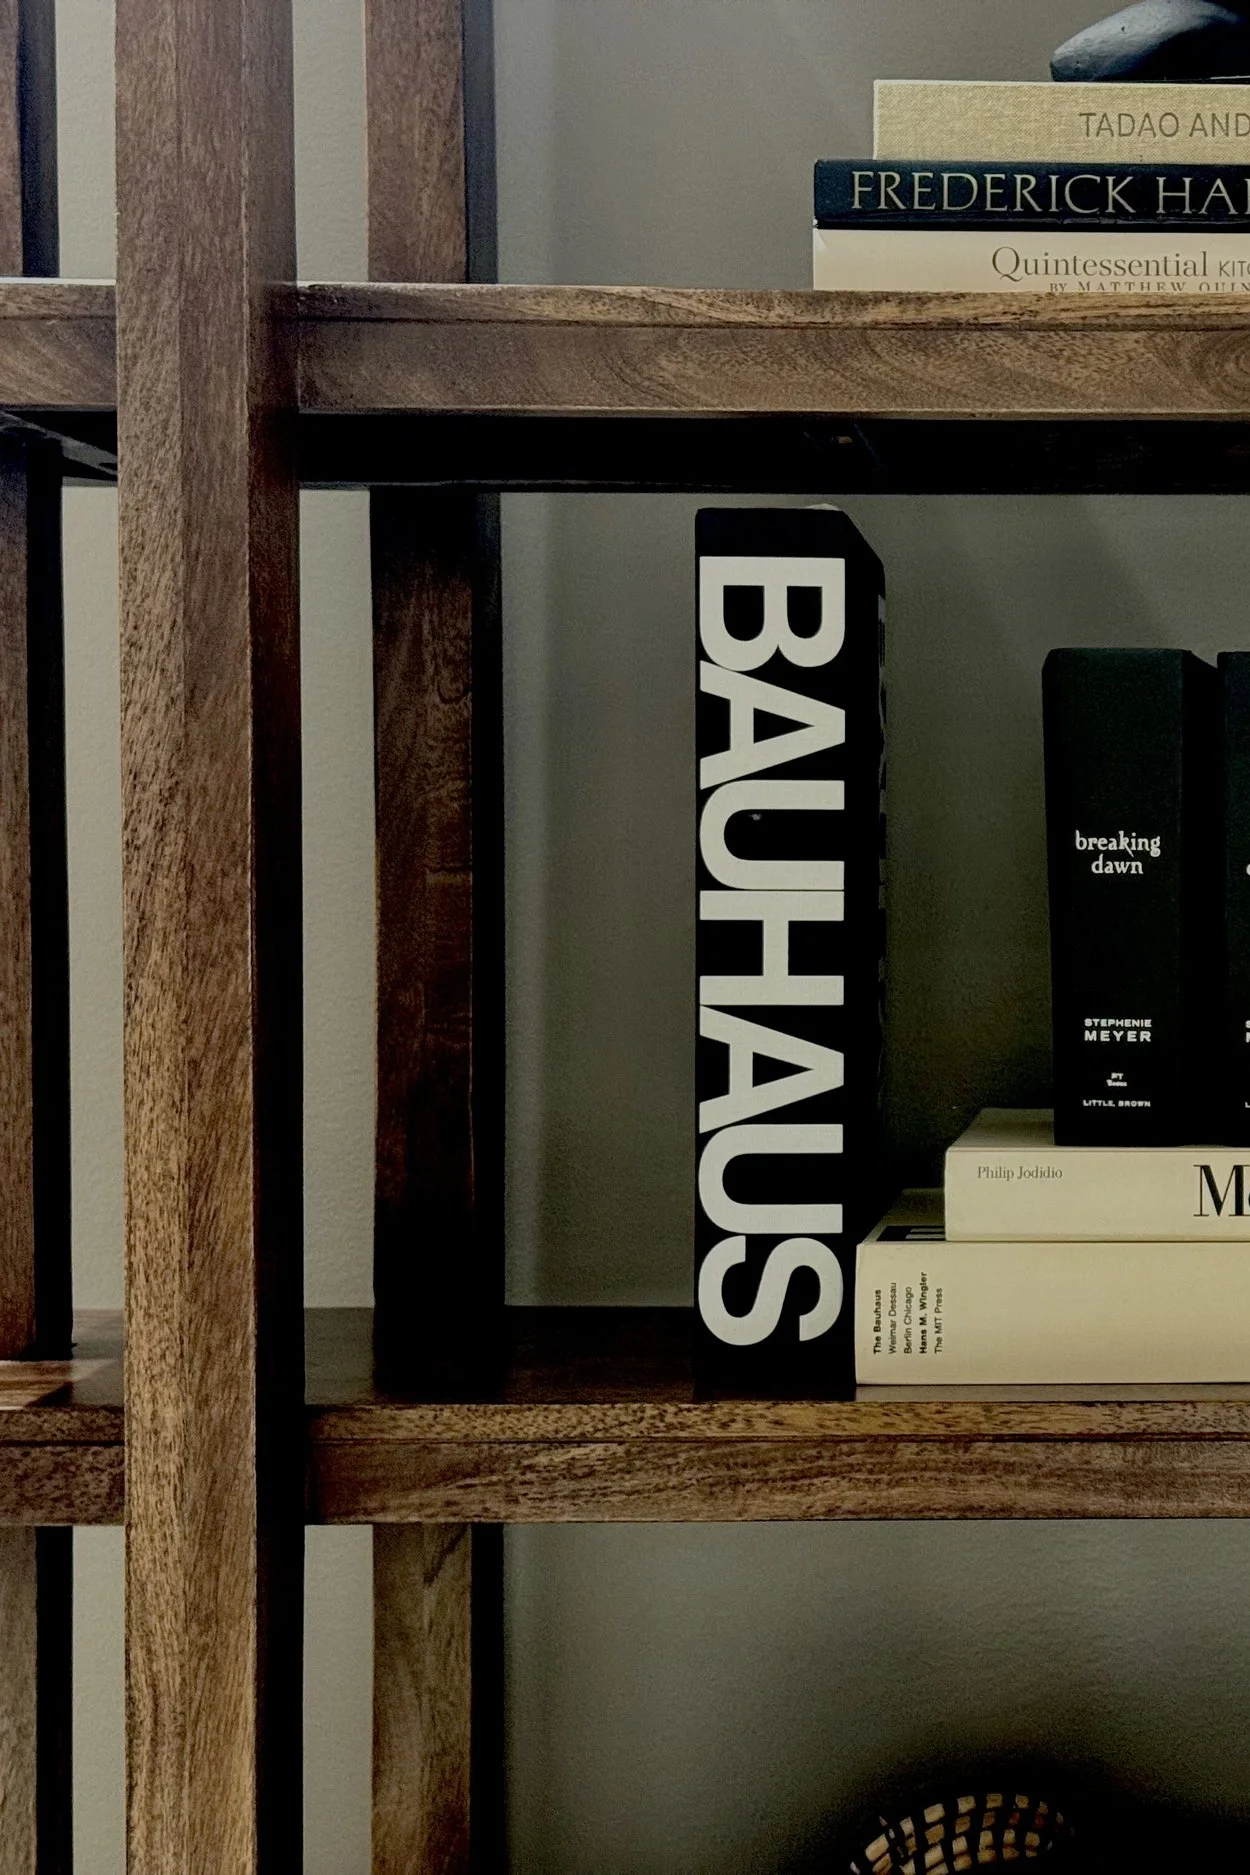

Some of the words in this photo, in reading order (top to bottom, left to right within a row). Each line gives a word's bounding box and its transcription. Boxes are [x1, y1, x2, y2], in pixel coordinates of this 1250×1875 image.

[1078, 112, 1179, 138] TADAO
[852, 171, 1136, 213] FREDERICK
[992, 246, 1208, 282] Quintessential
[1076, 830, 1160, 858] breaking
[1092, 853, 1143, 874] dawn
[698, 556, 846, 1348] BAUHAUS
[1084, 1017, 1152, 1028] STEPHENIE
[1084, 1029, 1152, 1043] MEYER
[1117, 1100, 1151, 1108] BROWN
[977, 1165, 1015, 1182] Philip
[1016, 1165, 1063, 1180] Jodidio
[887, 1282, 898, 1317] Dessau
[918, 1271, 929, 1311] Wingler
[933, 1287, 943, 1314] Press
[872, 1289, 882, 1333] Bauhaus
[903, 1286, 915, 1326] Chicago
[919, 1313, 928, 1326] M.
[934, 1316, 943, 1335] MIT
[872, 1335, 882, 1355] The
[888, 1319, 898, 1355] Weimar
[903, 1327, 913, 1355] Berlin
[919, 1329, 928, 1354] Hans
[933, 1336, 943, 1355] The
